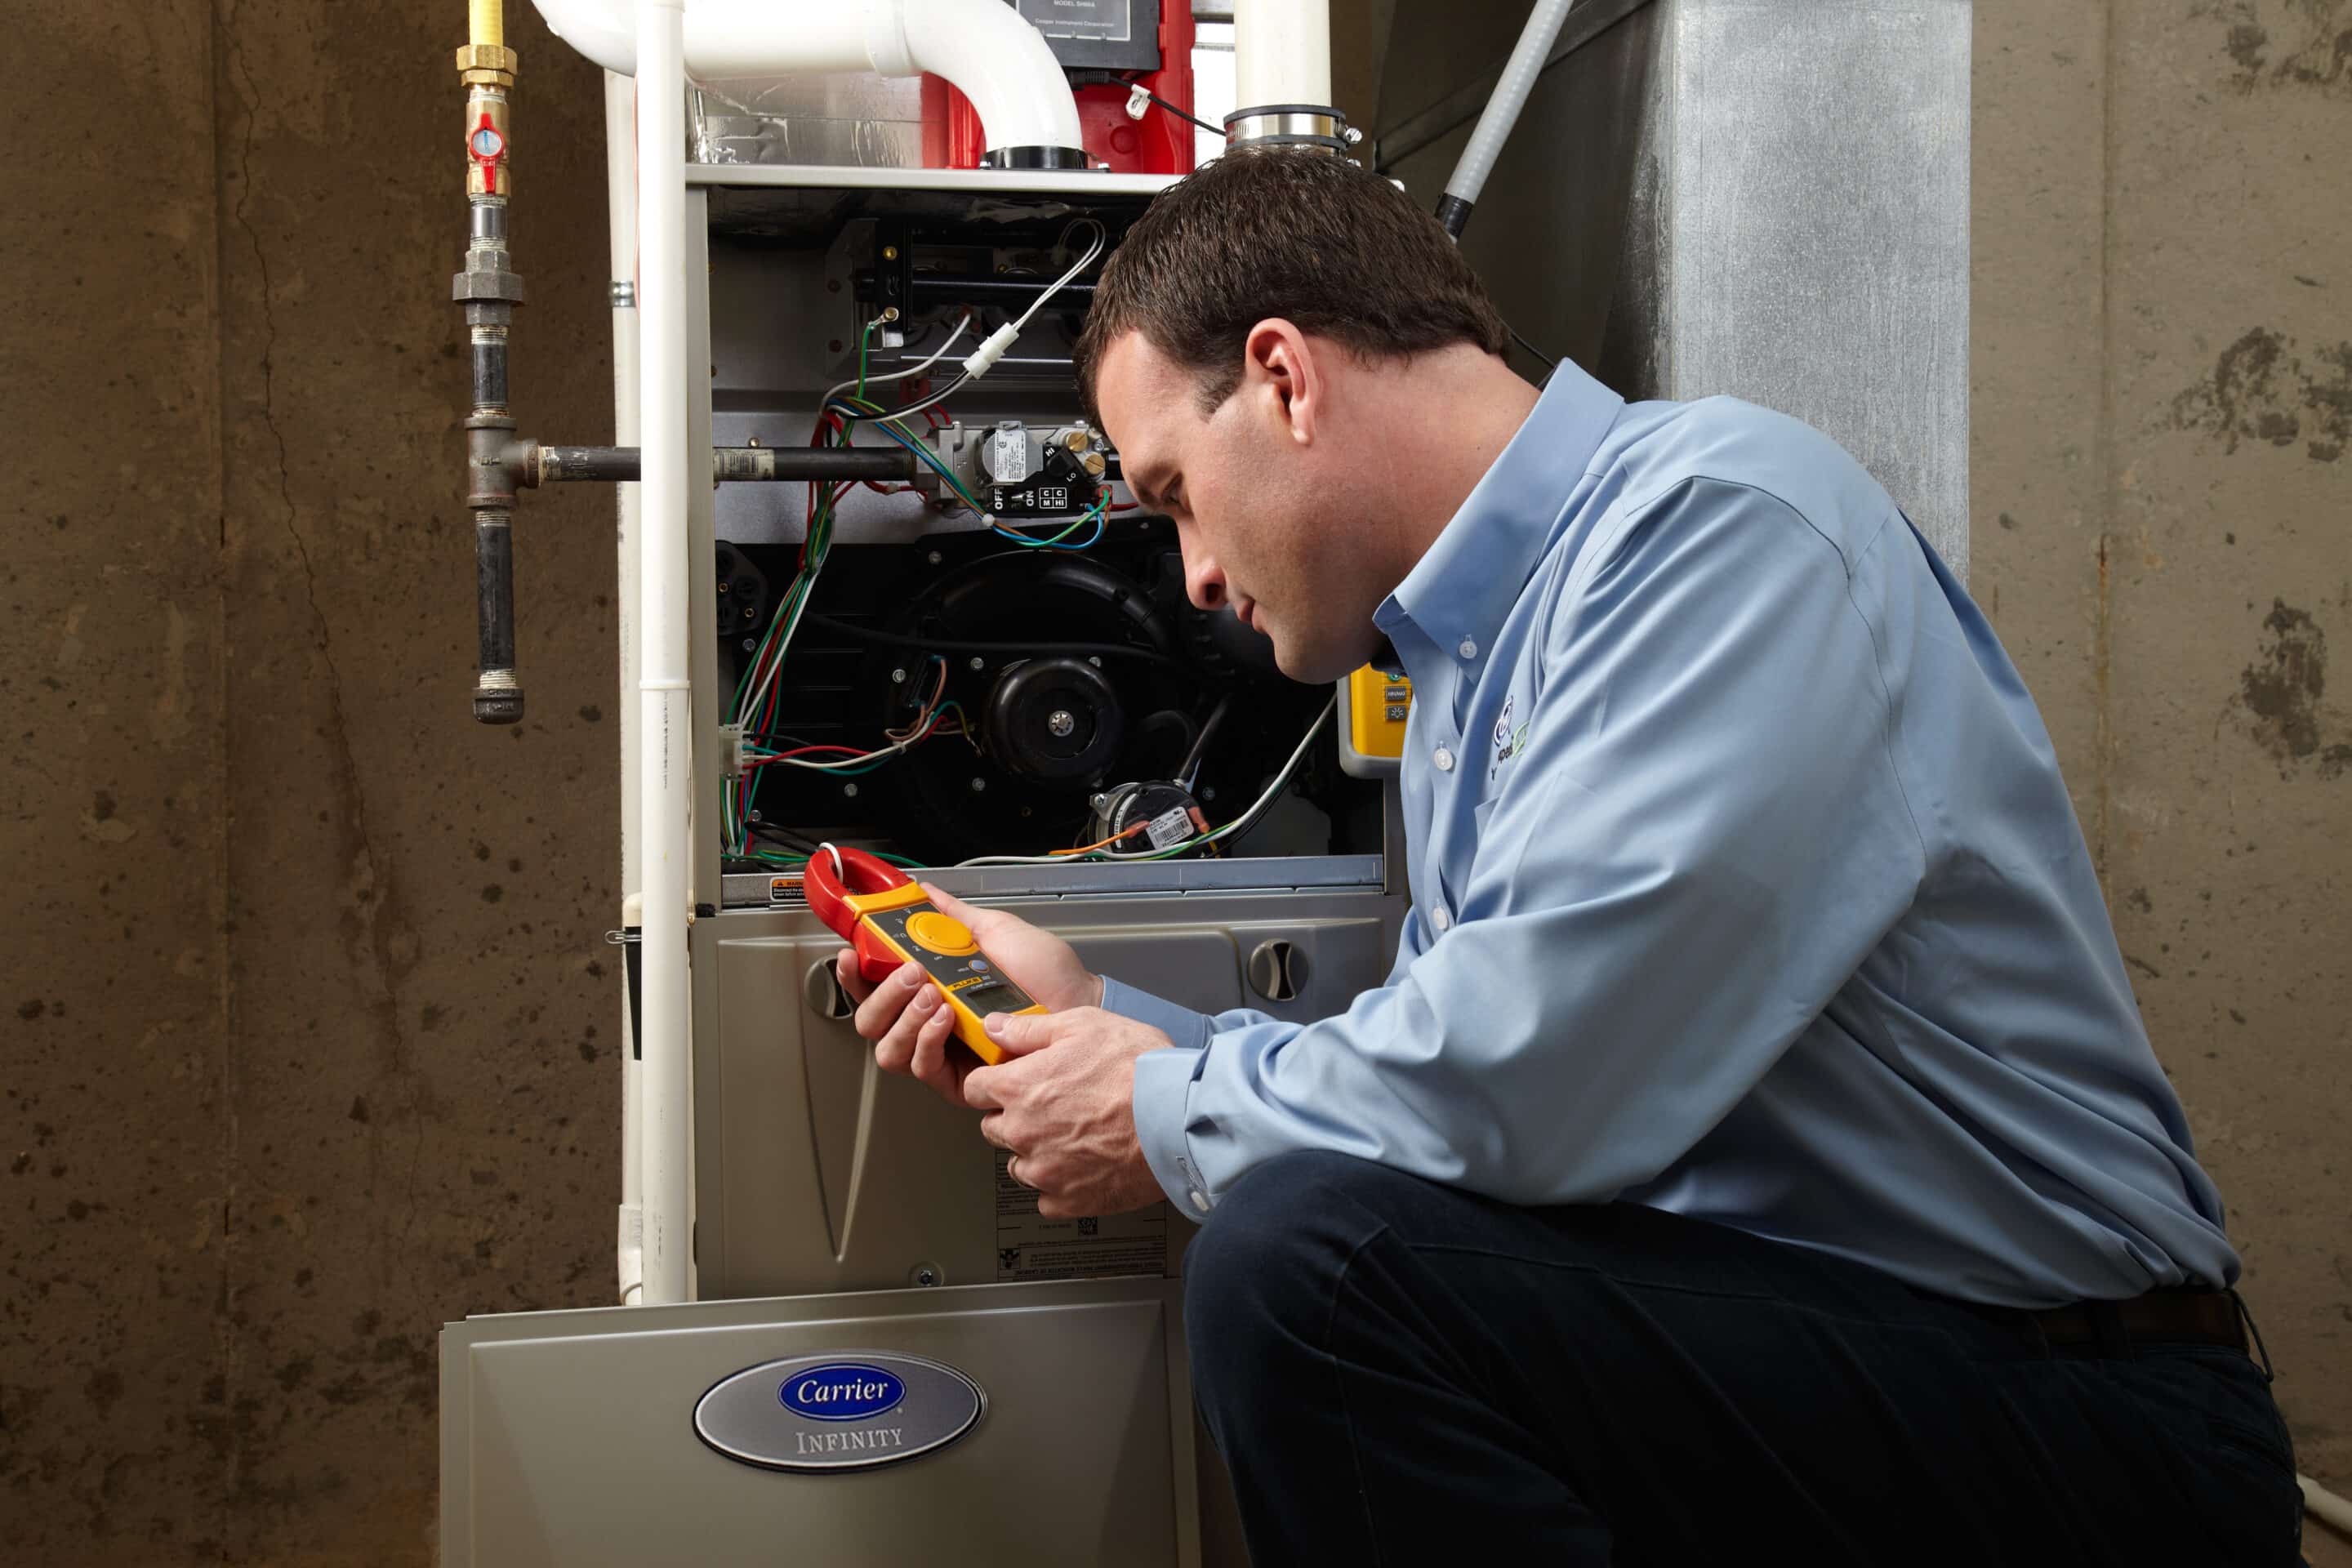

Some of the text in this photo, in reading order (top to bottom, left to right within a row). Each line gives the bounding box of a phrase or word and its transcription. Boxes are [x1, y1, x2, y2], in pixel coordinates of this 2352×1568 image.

[1045, 447, 1055, 457] HI
[1066, 472, 1076, 482] LO
[995, 488, 1003, 510] OFF
[1026, 490, 1034, 506] ON
[797, 1379, 889, 1404] Carrier
[795, 1428, 902, 1454] INFINITY
